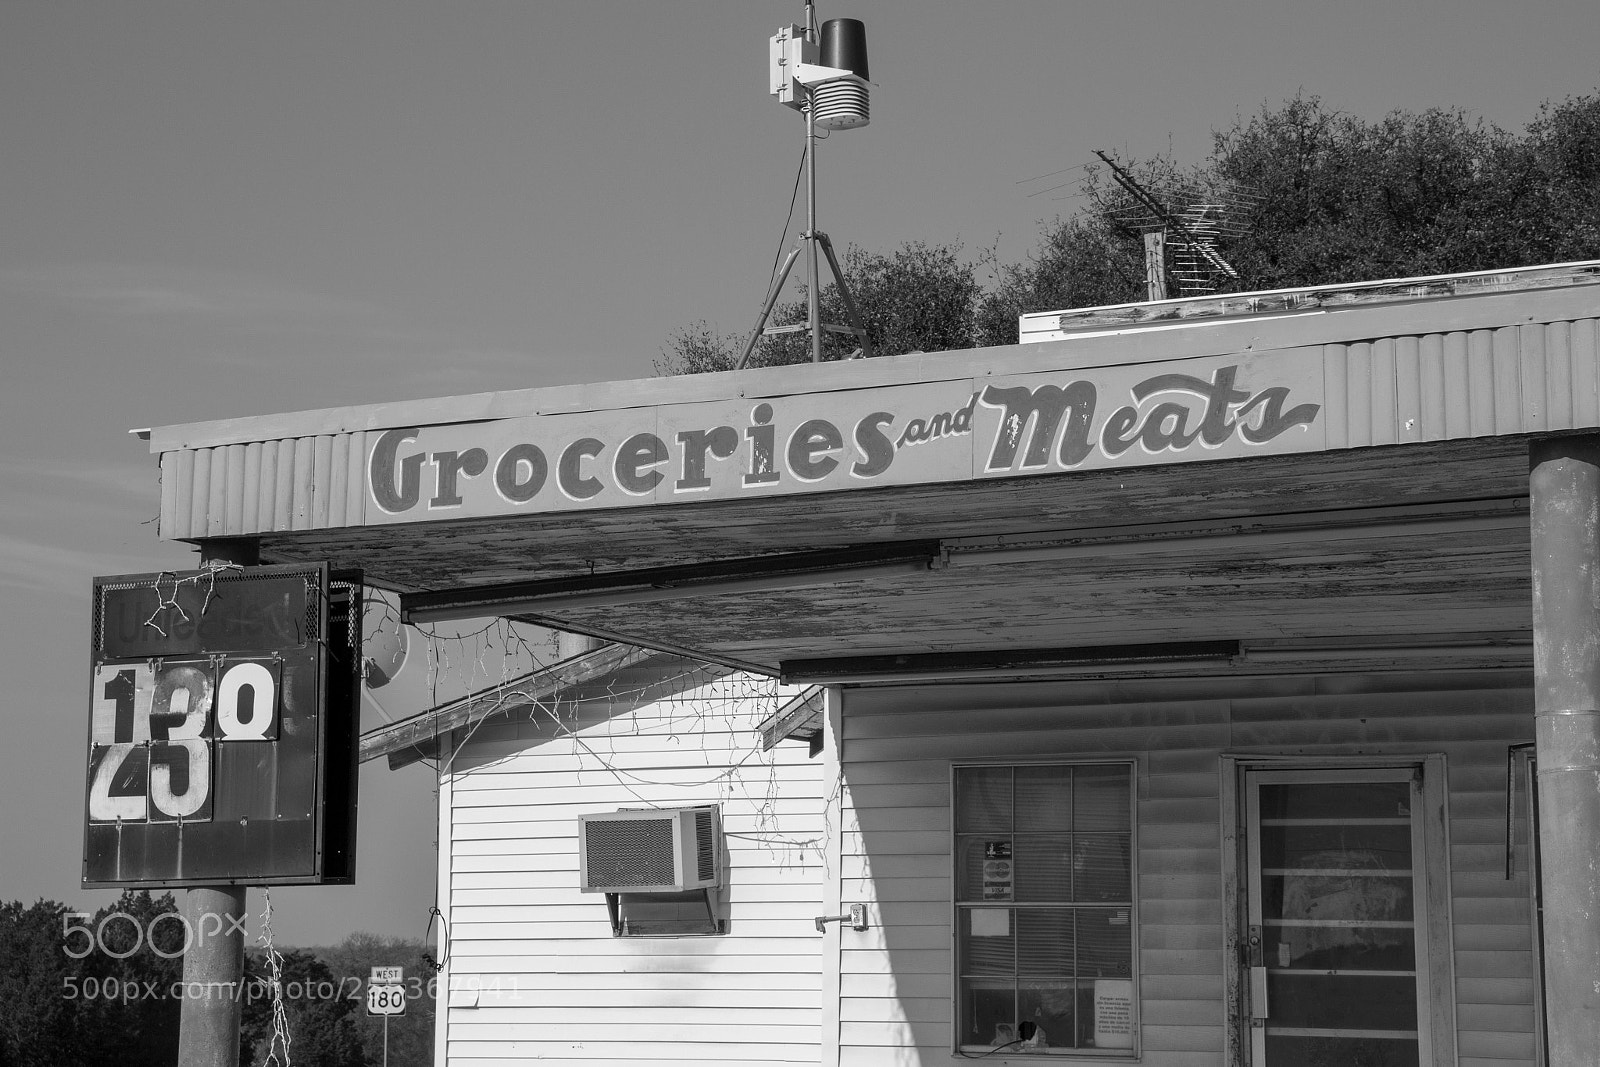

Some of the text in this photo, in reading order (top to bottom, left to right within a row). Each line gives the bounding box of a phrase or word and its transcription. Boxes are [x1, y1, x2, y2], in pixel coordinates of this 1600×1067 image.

[369, 365, 1320, 515] Groceries and Meats
[376, 969, 398, 980] WEST
[371, 991, 402, 1008] 180
